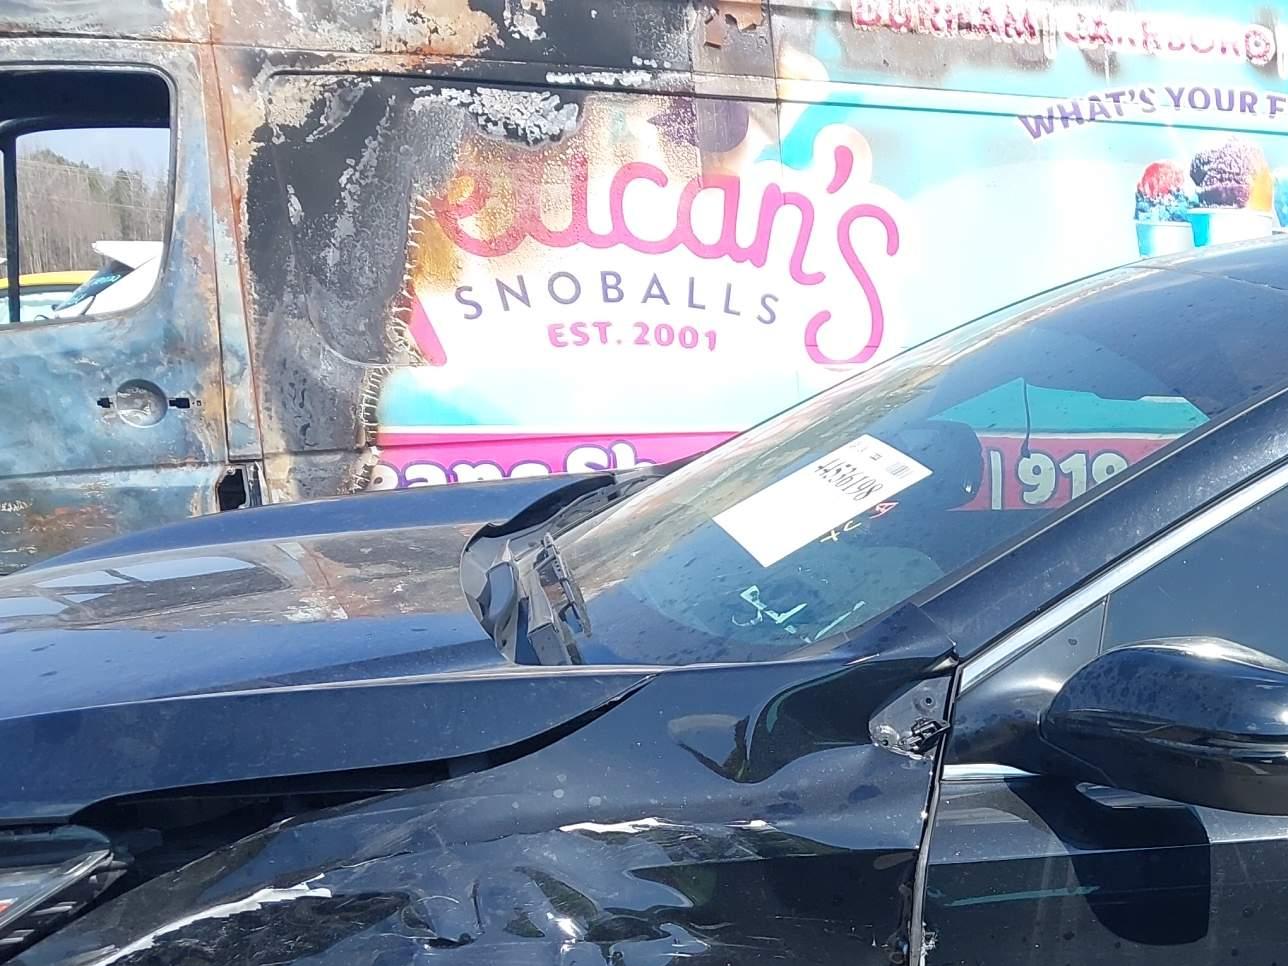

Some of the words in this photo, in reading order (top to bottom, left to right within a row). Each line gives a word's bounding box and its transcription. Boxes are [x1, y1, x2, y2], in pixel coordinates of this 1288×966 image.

[1018, 87, 1157, 140] WHAT'S
[1165, 86, 1258, 114] YOUR
[454, 270, 780, 325] SNOBALLS
[546, 321, 623, 349] EST.
[633, 321, 718, 352] 2001
